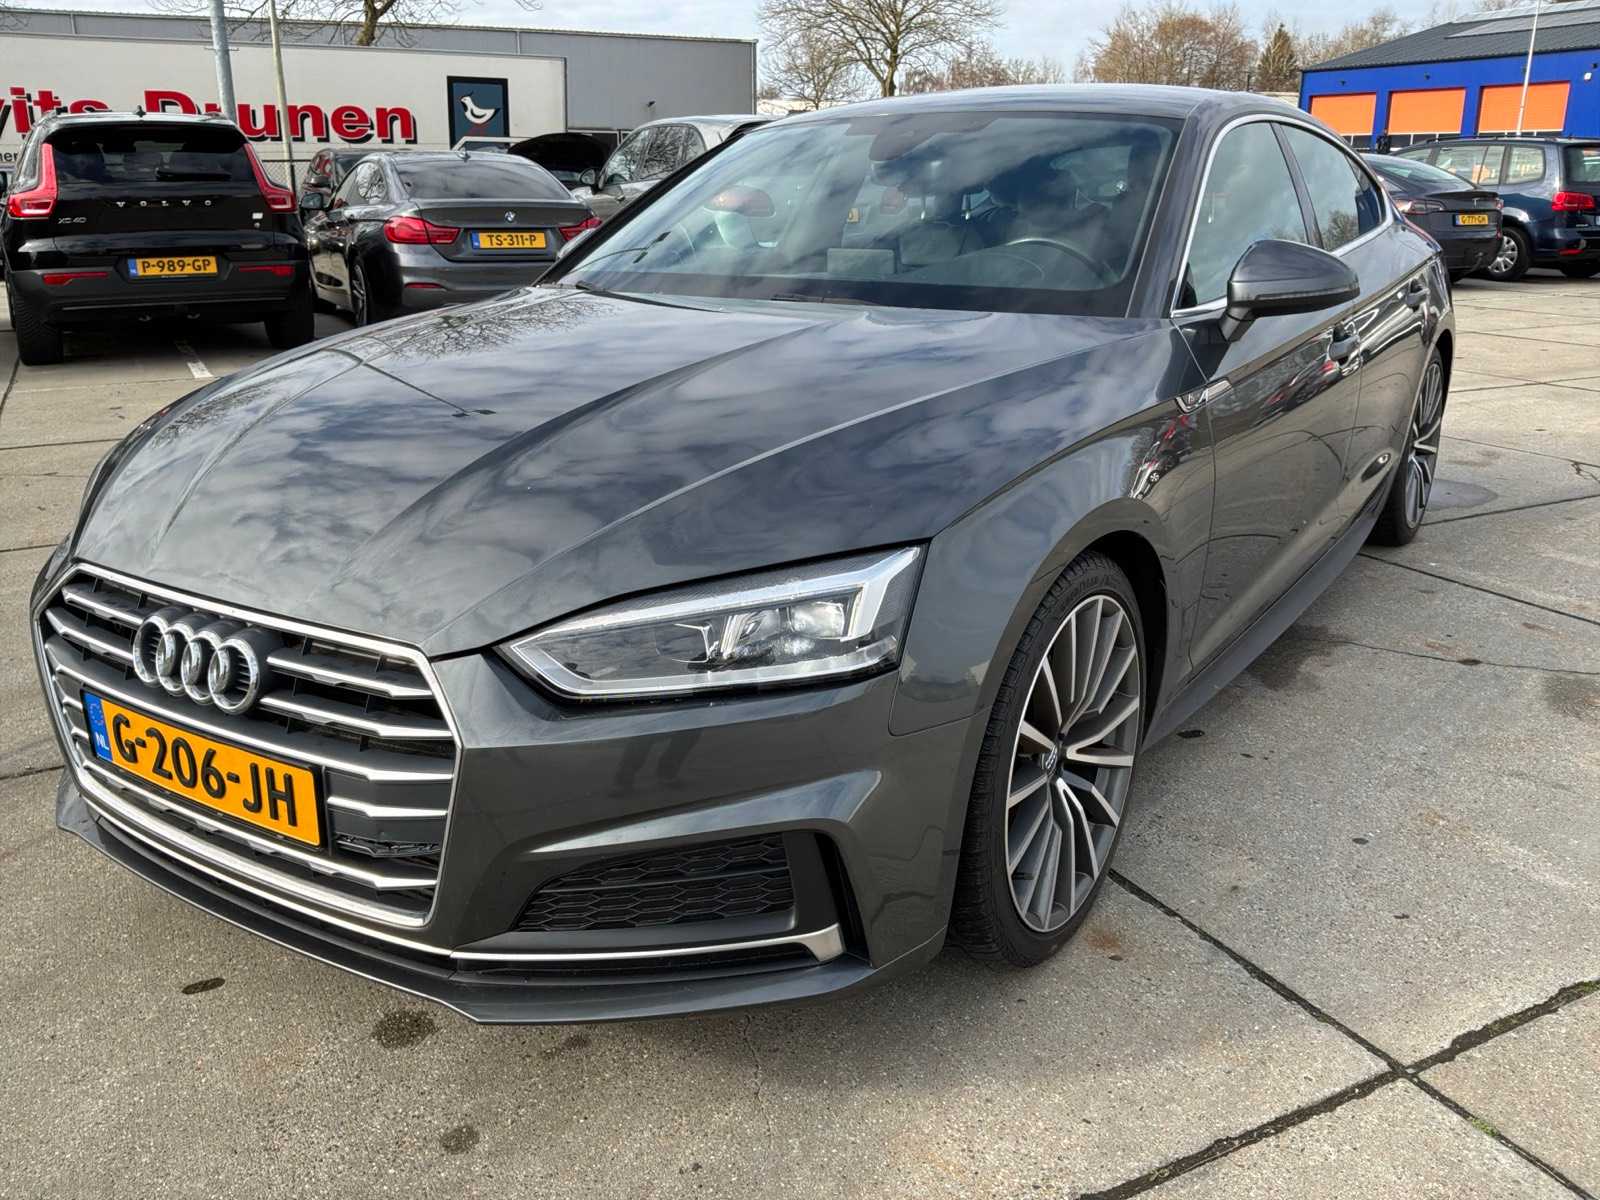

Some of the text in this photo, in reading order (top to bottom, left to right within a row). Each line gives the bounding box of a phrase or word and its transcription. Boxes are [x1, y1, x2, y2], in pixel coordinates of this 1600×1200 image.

[116, 200, 212, 208] VOLVO
[487, 234, 537, 246] TS-311-P
[142, 259, 211, 273] P-989-GP
[95, 731, 110, 750] NL
[112, 713, 298, 827] G-206-JH
